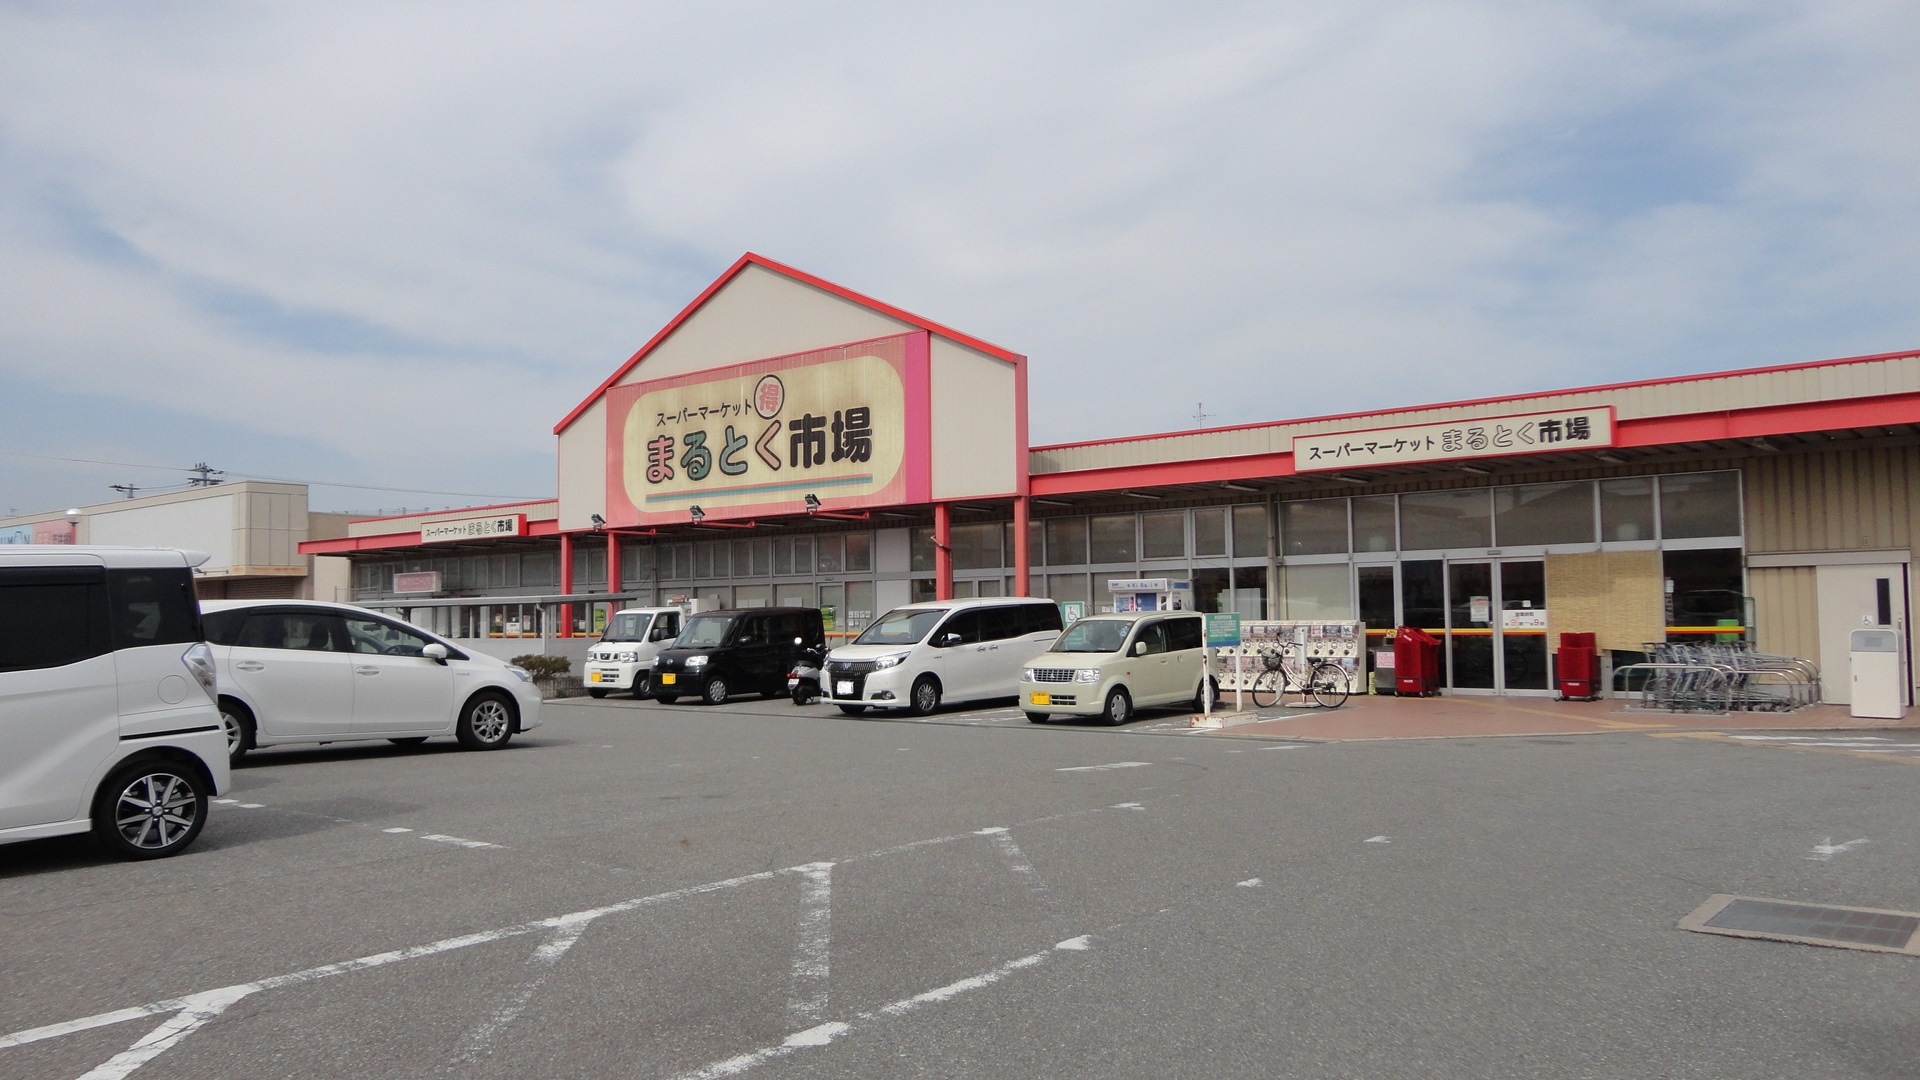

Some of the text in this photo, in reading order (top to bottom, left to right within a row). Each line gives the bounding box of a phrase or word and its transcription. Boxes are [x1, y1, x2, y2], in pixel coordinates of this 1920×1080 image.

[656, 398, 752, 427] スーパーマーケット
[646, 407, 873, 484] まるとく市場
[1309, 416, 1592, 461] スーパーマーケット まるとく市場
